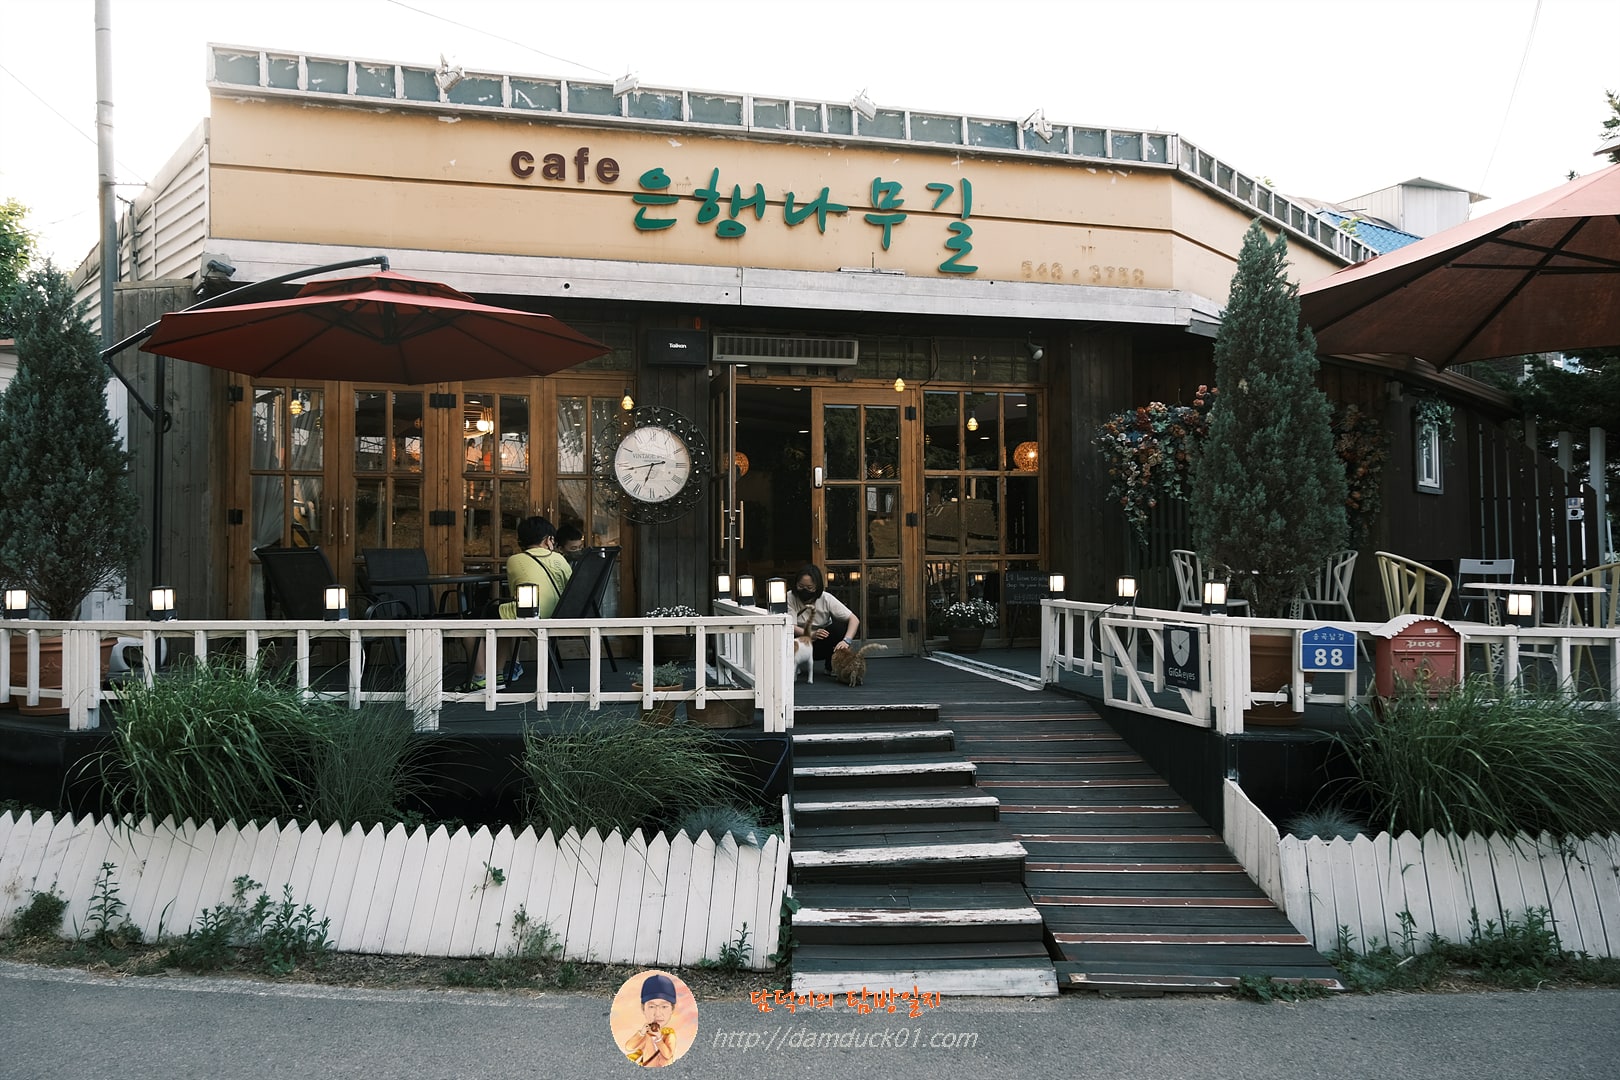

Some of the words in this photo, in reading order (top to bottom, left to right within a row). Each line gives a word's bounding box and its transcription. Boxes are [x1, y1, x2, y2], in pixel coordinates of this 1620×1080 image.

[510, 147, 620, 184] cafe
[633, 167, 978, 274] 은행나무길
[1314, 648, 1344, 667] 88
